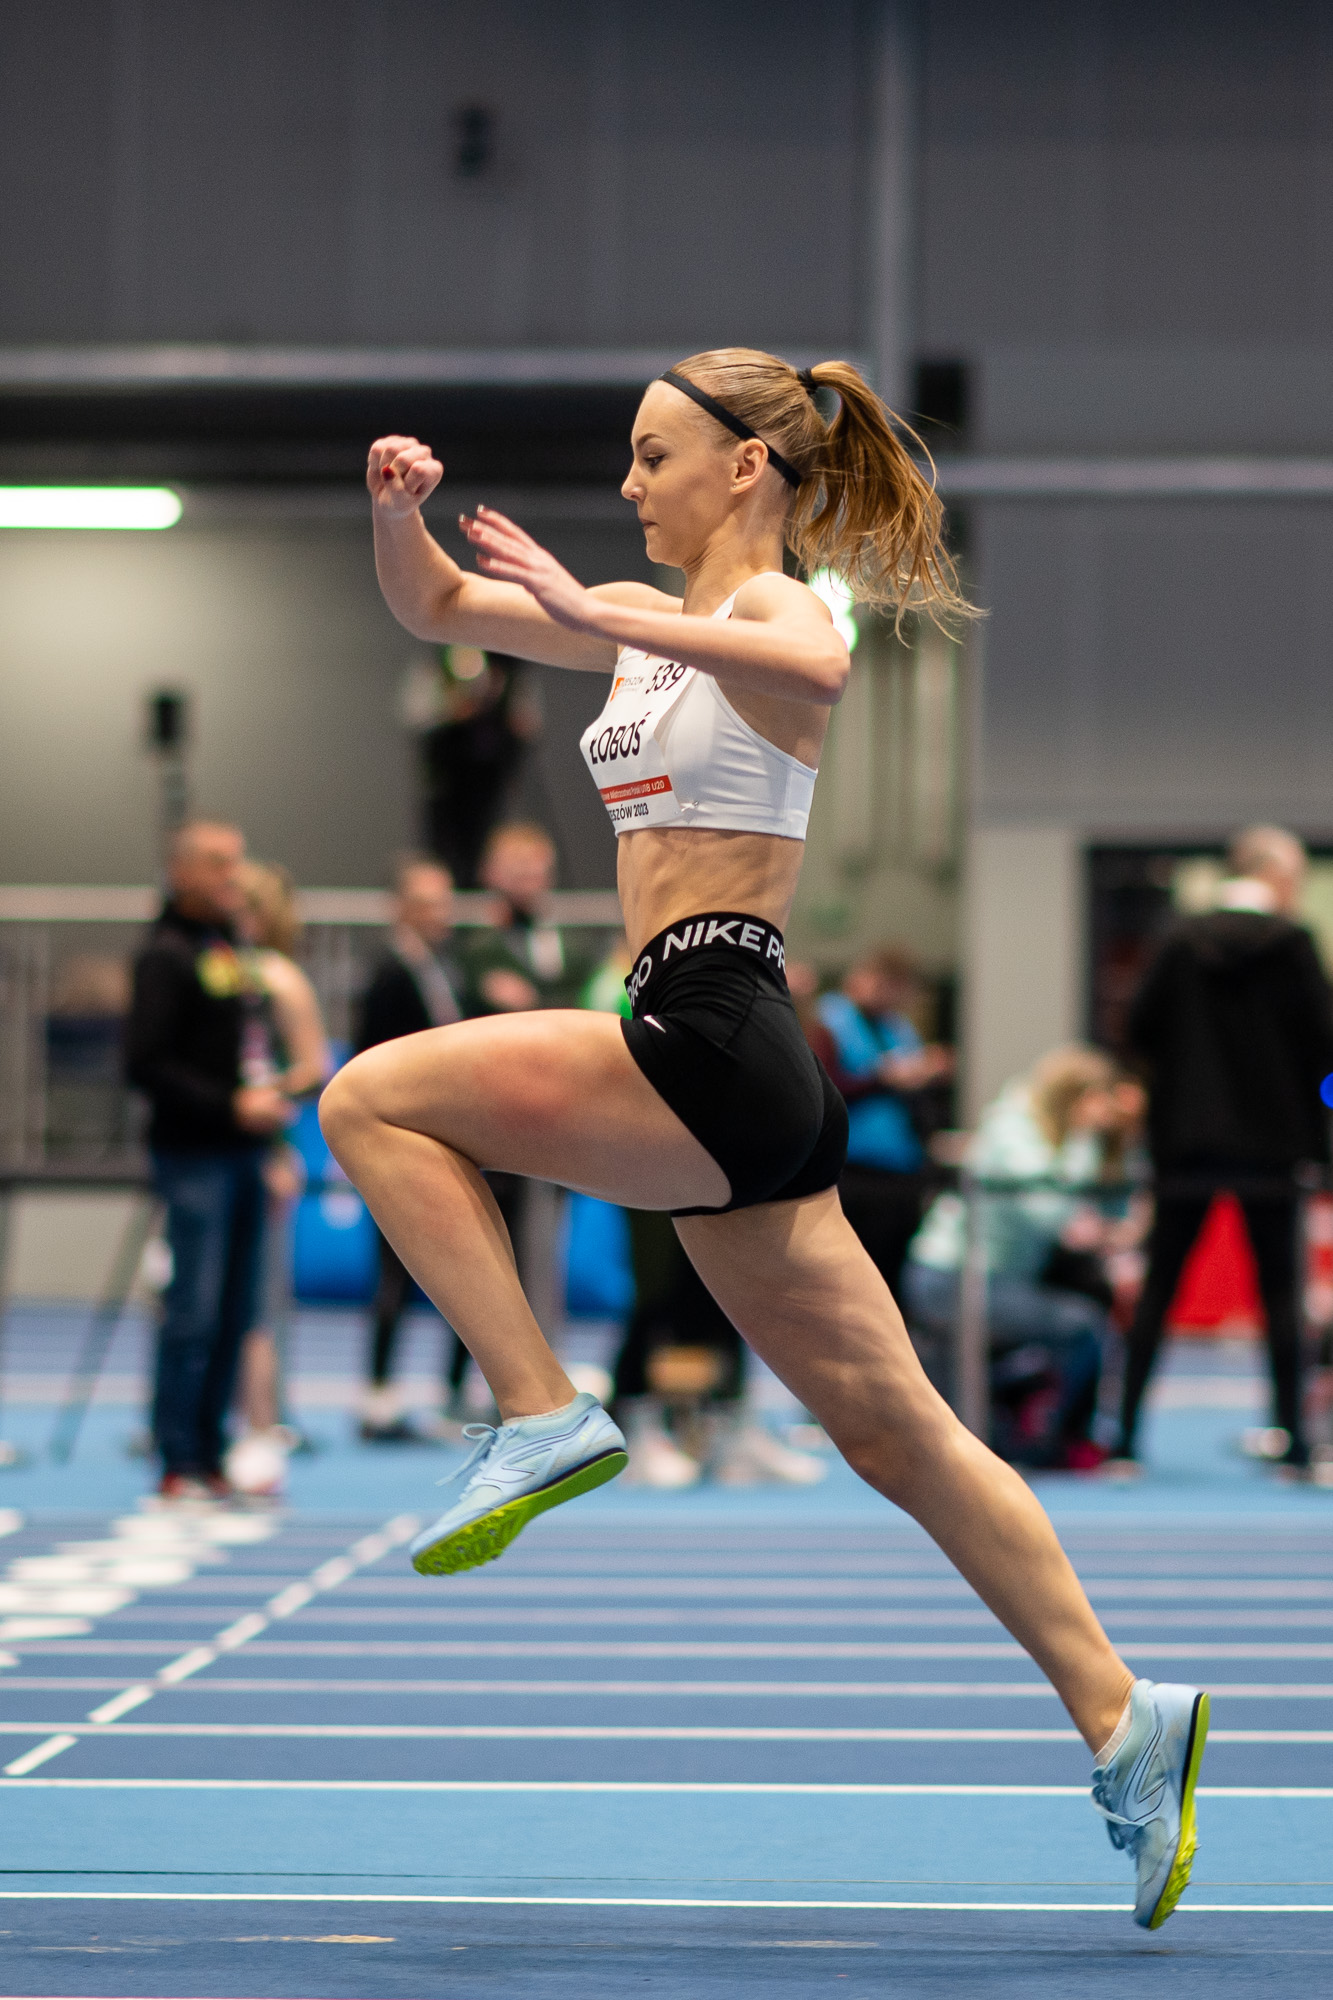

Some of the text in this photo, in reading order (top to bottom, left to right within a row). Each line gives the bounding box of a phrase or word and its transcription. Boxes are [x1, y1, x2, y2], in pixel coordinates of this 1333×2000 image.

[645, 662, 687, 694] 539
[651, 780, 664, 791] U20
[633, 802, 649, 817] 2023
[662, 920, 765, 961] NIKE
